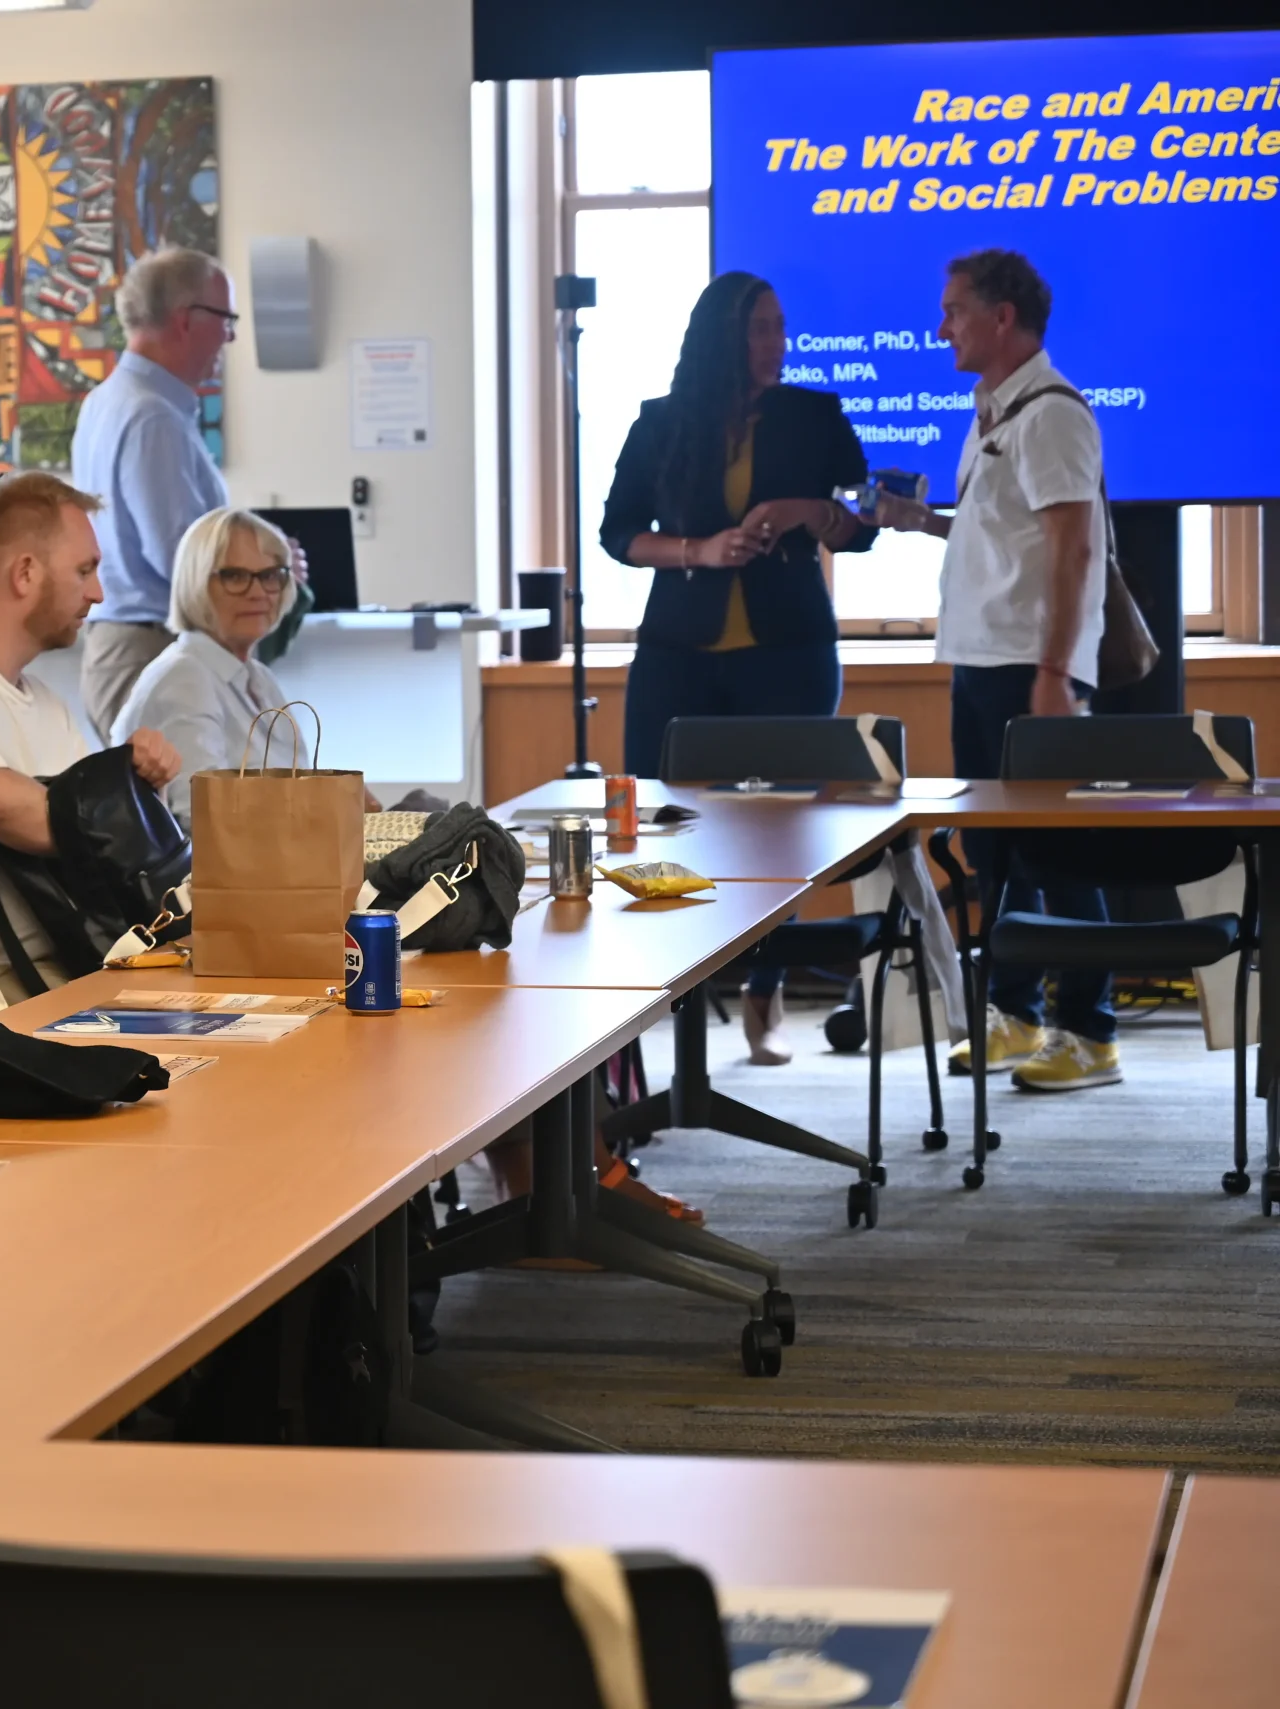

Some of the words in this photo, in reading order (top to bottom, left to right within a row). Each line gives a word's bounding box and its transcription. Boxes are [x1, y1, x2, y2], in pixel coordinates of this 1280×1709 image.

[914, 90, 1030, 122] Race
[1042, 83, 1131, 118] and
[1137, 77, 1280, 115] Ameri
[766, 139, 847, 171] The
[862, 132, 980, 171] Work
[988, 130, 1036, 164] of
[1053, 129, 1135, 161] The
[812, 180, 900, 214] and
[909, 175, 1053, 211] Social
[1062, 171, 1278, 206] Problems
[797, 333, 868, 352] Conner,
[874, 331, 919, 351] PhD,
[834, 363, 877, 381] MPA
[840, 398, 873, 412] ace
[878, 393, 912, 411] and
[918, 392, 974, 410] Social
[1080, 388, 1146, 410] CRSP)
